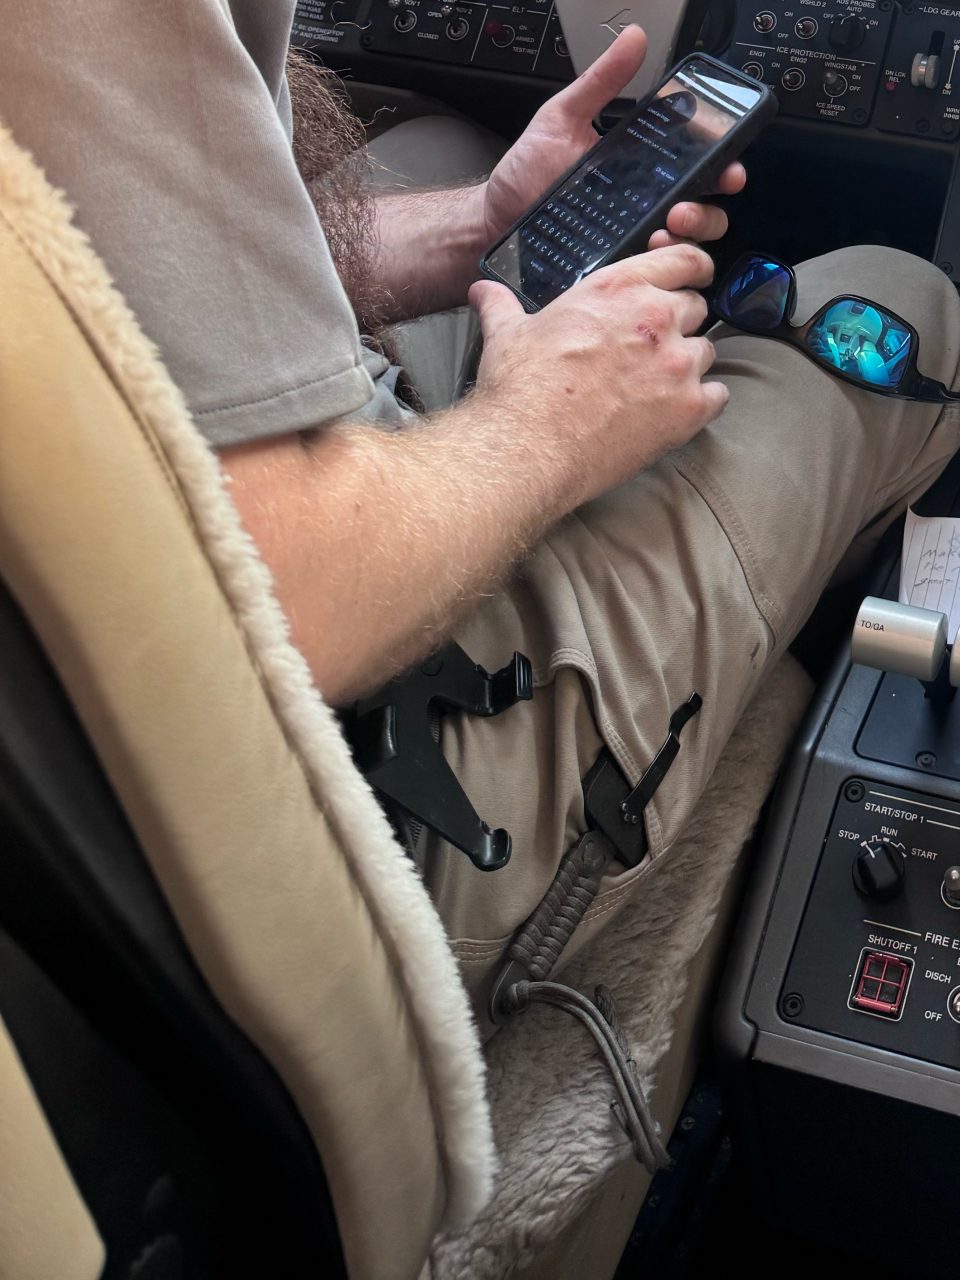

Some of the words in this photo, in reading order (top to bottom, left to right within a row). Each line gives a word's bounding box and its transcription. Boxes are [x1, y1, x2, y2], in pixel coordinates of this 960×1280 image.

[512, 6, 525, 14] ELT
[846, 5, 862, 13] AUTO
[849, 0, 876, 9] PROBES
[923, 6, 939, 15] LDG
[749, 49, 766, 58] ENG1
[776, 45, 790, 54] ICE
[790, 47, 837, 61] PROTECTION
[790, 56, 808, 64] ENG2
[824, 61, 857, 71] WINGSTAB
[860, 619, 885, 632] TO/GA
[864, 802, 918, 821] START/STOP
[920, 816, 924, 824] 1
[838, 829, 860, 840] STOP
[880, 826, 899, 837] RUN
[911, 847, 938, 861] START
[868, 934, 912, 952] SHUTOFF
[913, 946, 918, 955] 1
[925, 932, 950, 948] FIRE
[925, 970, 952, 984] DISCH
[924, 1010, 943, 1022] OFF
